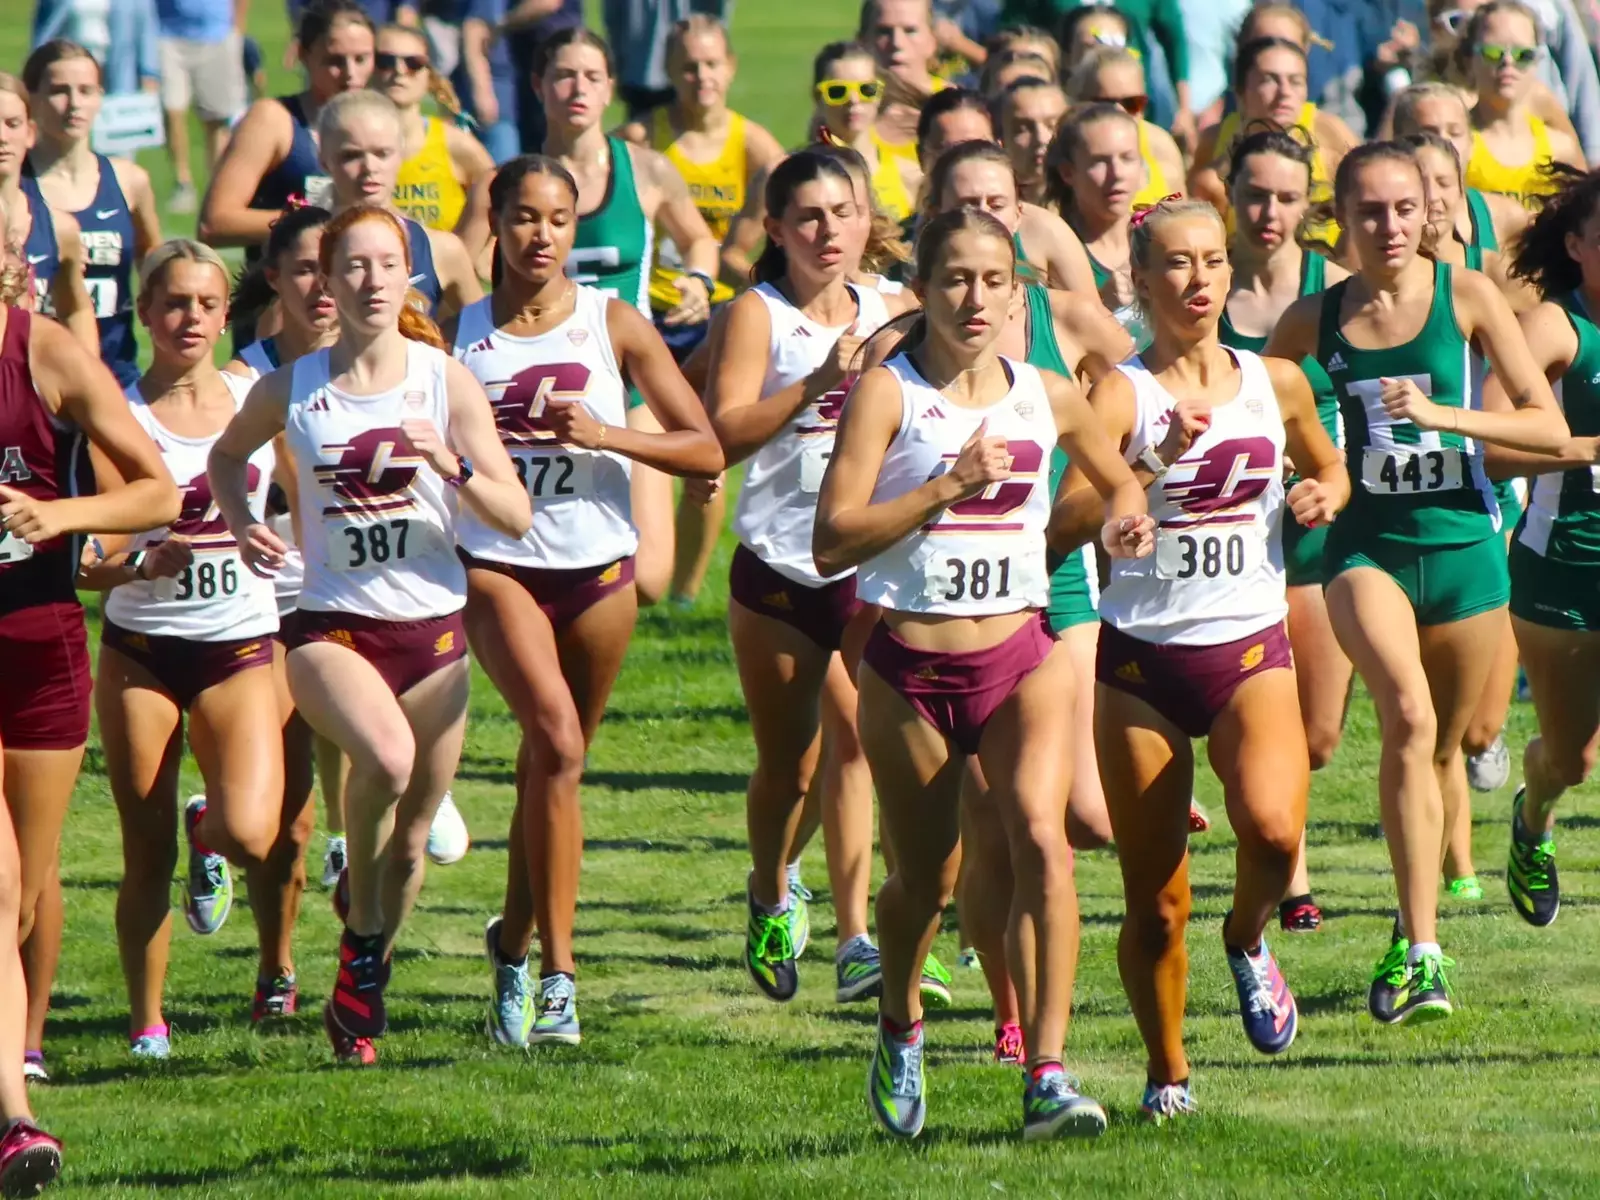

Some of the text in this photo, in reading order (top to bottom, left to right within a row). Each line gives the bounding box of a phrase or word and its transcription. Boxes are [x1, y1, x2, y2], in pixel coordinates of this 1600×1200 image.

[1380, 451, 1445, 492] 443
[344, 519, 410, 567] 387
[1177, 534, 1244, 578] 380
[175, 559, 238, 601] 386
[944, 556, 1011, 600] 381
